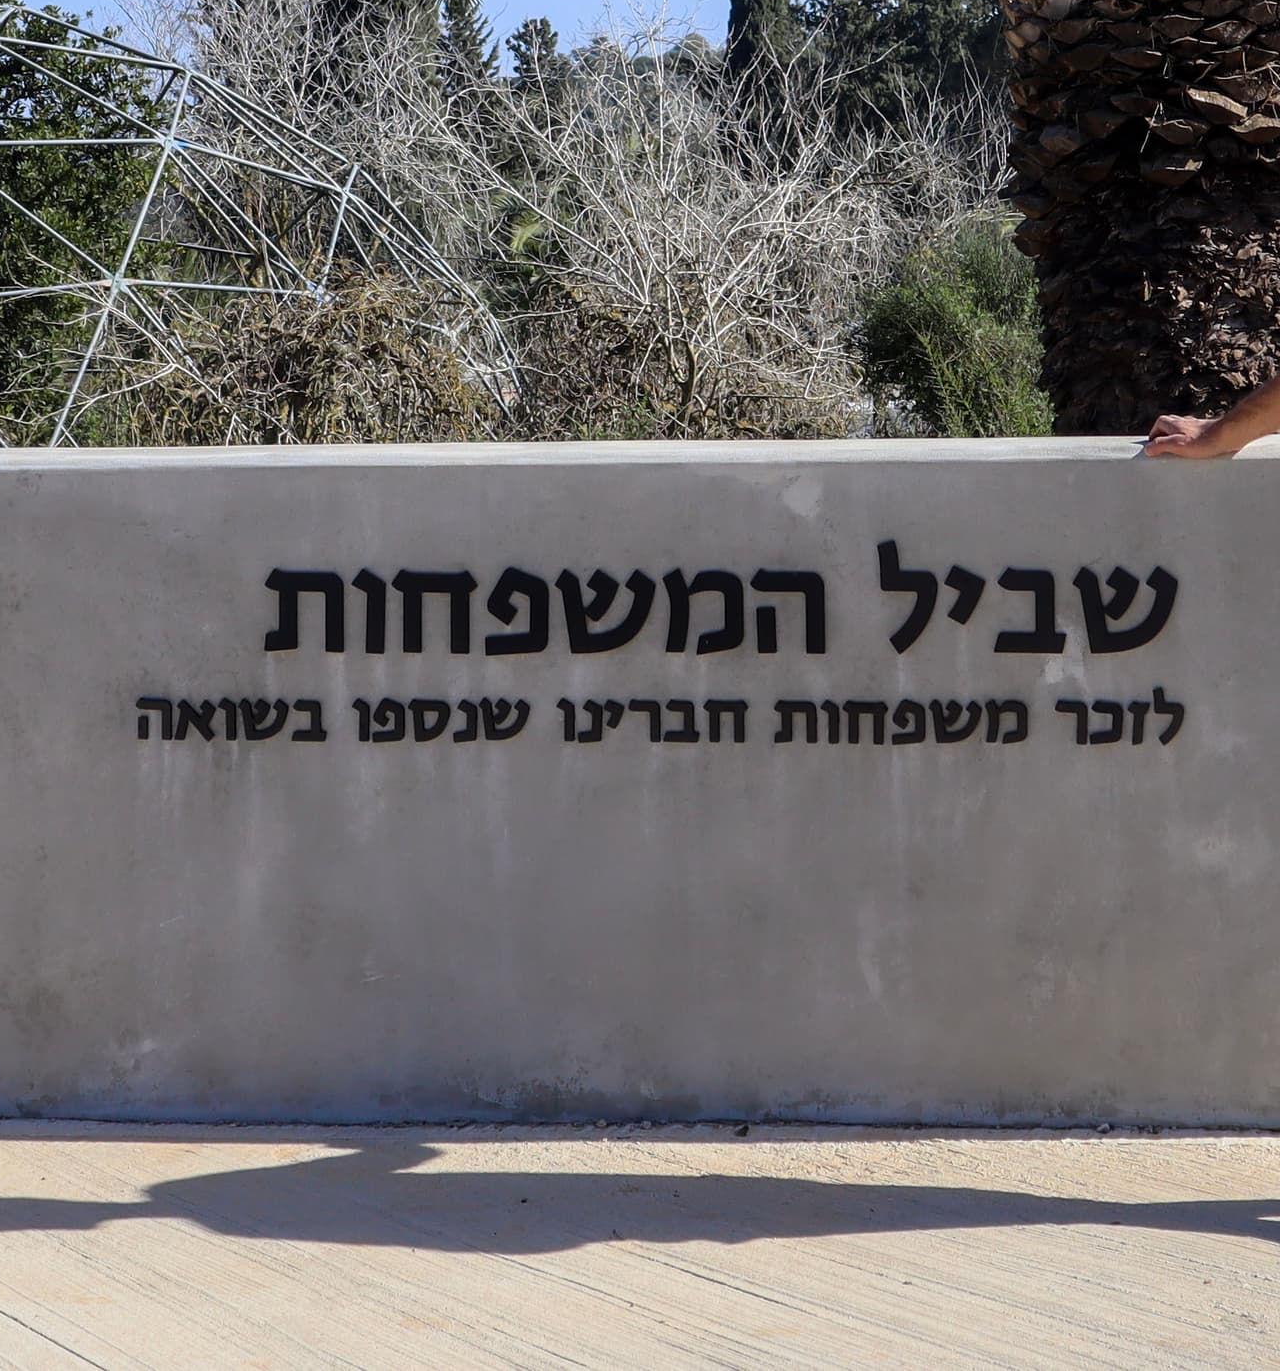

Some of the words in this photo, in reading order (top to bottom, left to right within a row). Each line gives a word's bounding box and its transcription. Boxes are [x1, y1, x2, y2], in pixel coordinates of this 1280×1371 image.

[264, 566, 827, 656] המשפחות
[877, 539, 1179, 655] שביל
[136, 696, 328, 743] בשואה
[352, 697, 531, 744] שנספו
[557, 698, 750, 744] חברינו
[774, 698, 1030, 745] משפחות
[1055, 687, 1185, 745] לזכר
